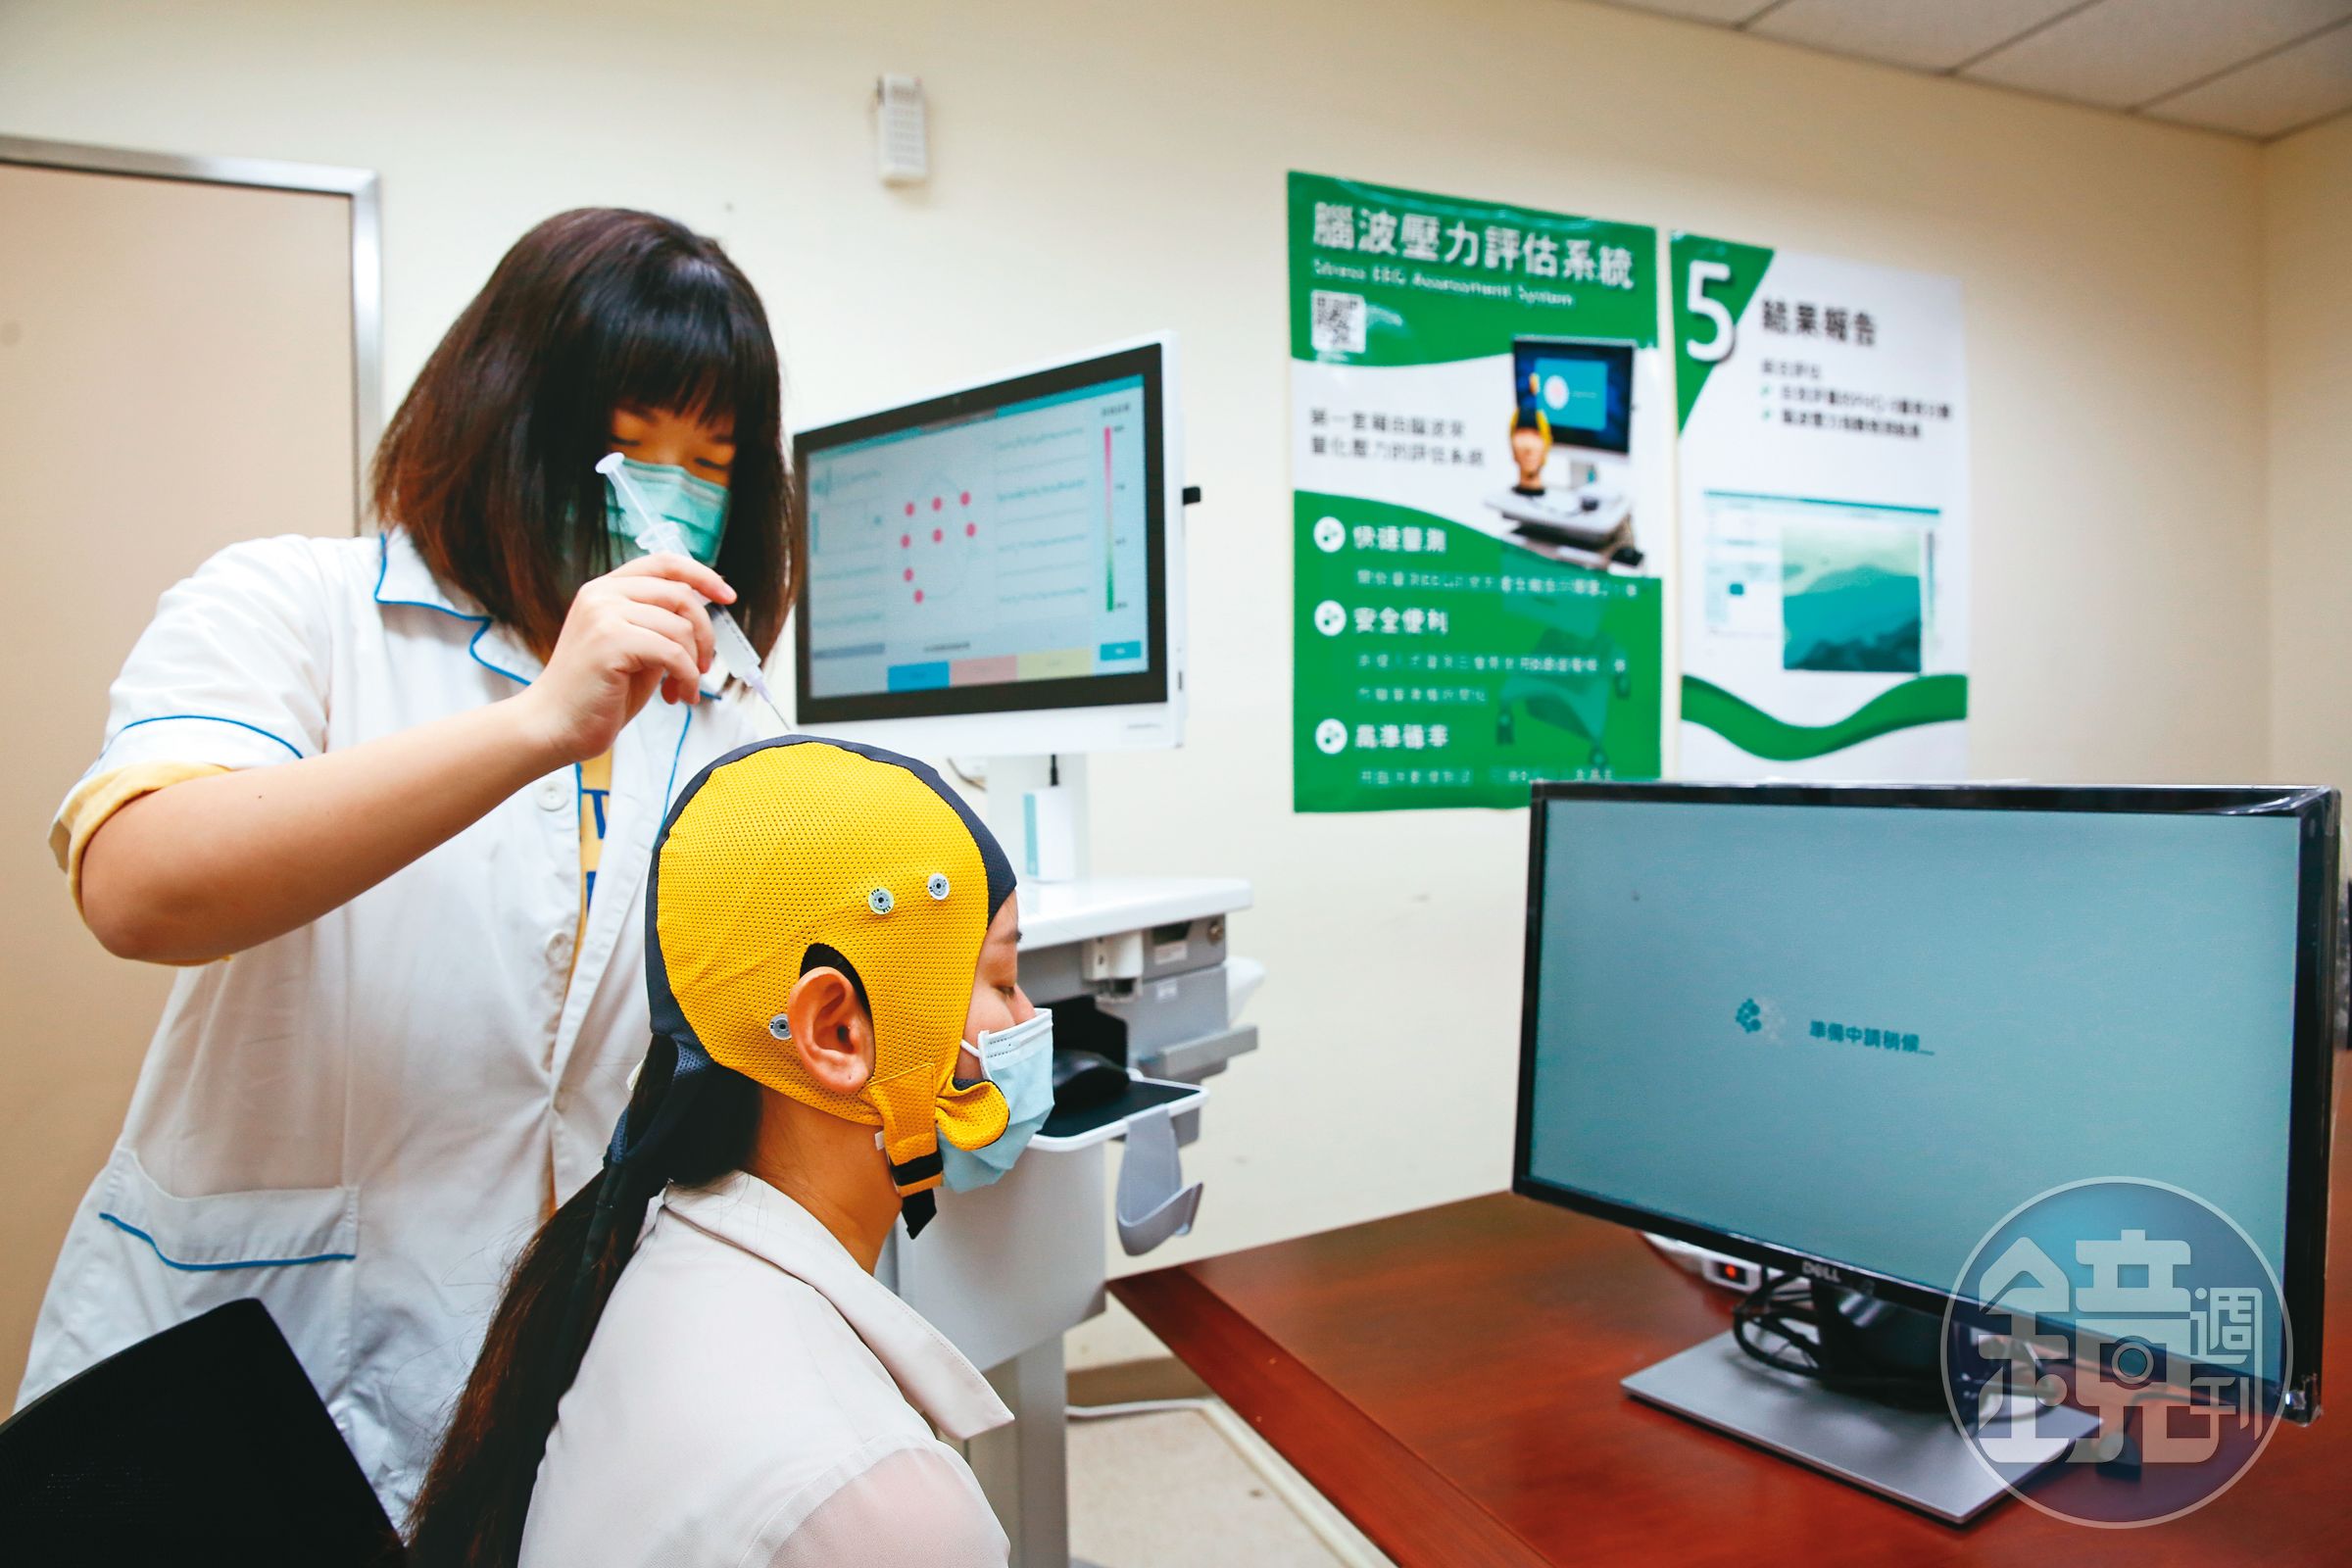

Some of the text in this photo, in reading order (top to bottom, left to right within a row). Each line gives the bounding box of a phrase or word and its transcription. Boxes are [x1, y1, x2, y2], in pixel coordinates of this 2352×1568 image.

[1312, 201, 1634, 290] 腦波壓力評估系統
[1687, 260, 1735, 362] 5
[1761, 298, 1877, 346] 結果報告
[1352, 606, 1449, 635] 安全便利
[1802, 1260, 1841, 1283] DELL
